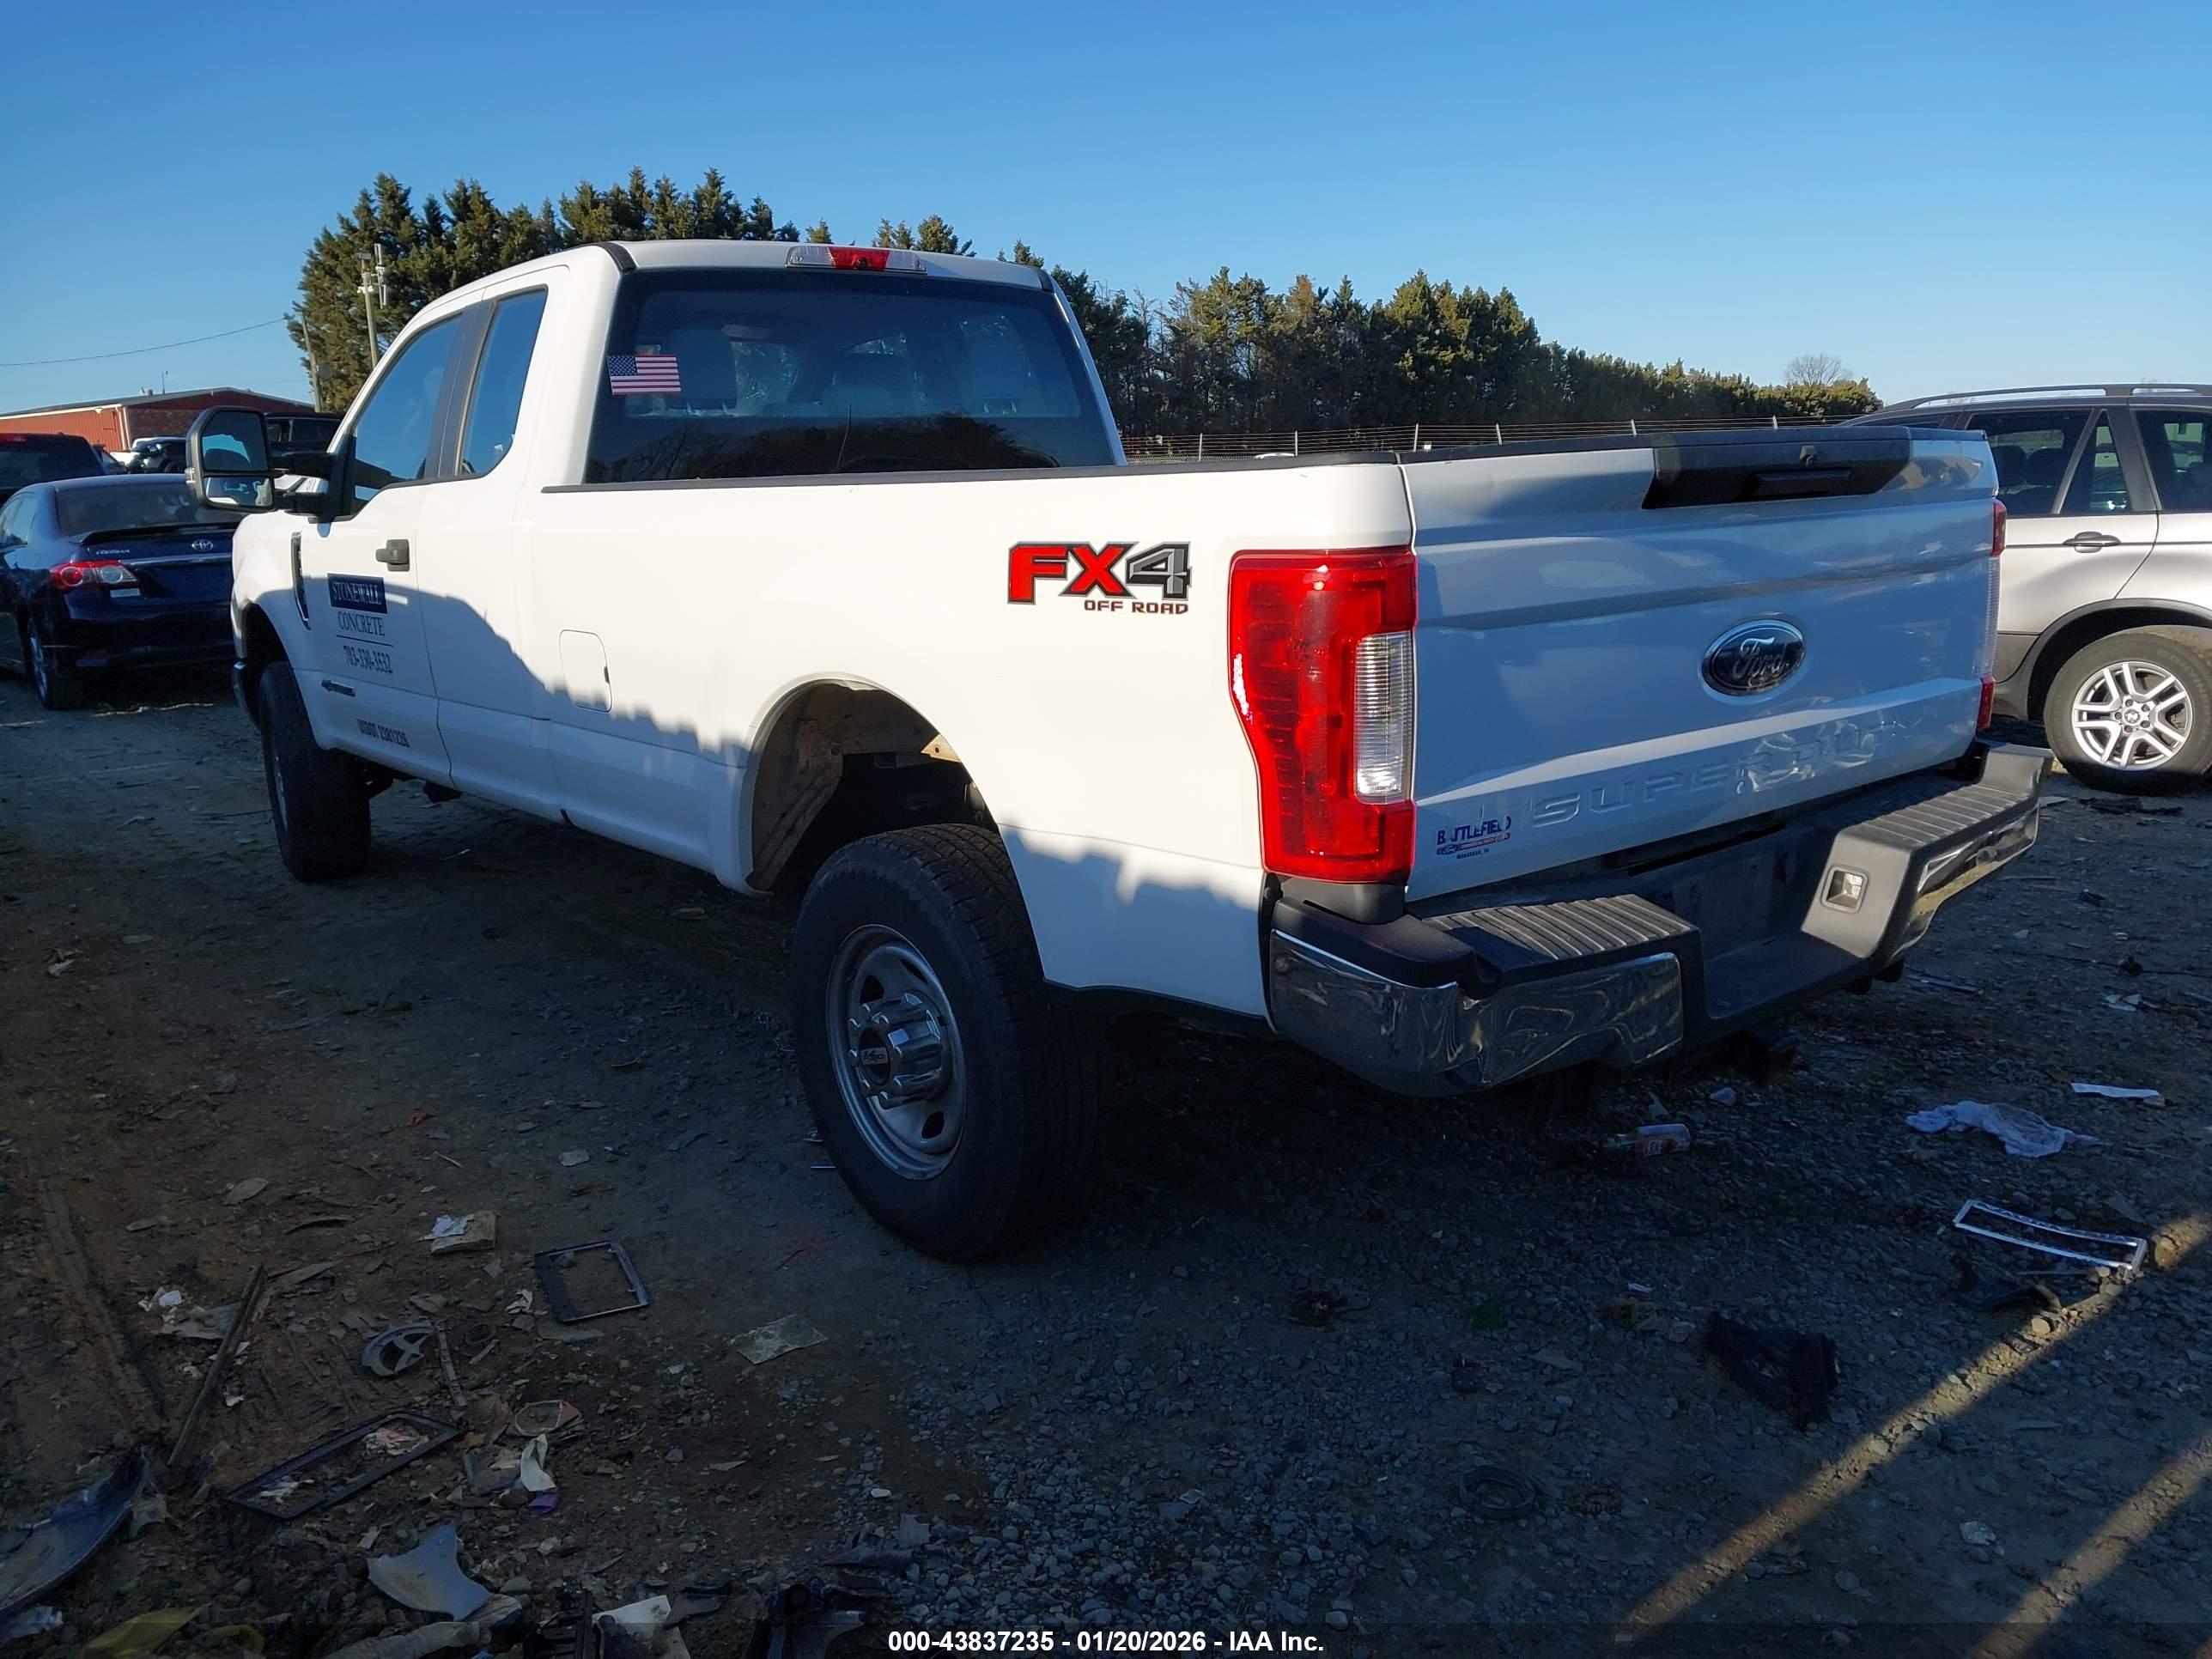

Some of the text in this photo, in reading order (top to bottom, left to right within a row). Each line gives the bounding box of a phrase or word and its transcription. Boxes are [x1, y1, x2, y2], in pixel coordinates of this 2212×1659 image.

[1007, 541, 1192, 605] FX4
[331, 581, 383, 605] STONEWALL
[1084, 599, 1189, 615] OFF ROAD
[337, 611, 386, 636] CONCRETE
[1732, 636, 1791, 679] Ford
[1532, 750, 1775, 829] SUPER
[1437, 816, 1511, 846] BTTLEFIELD
